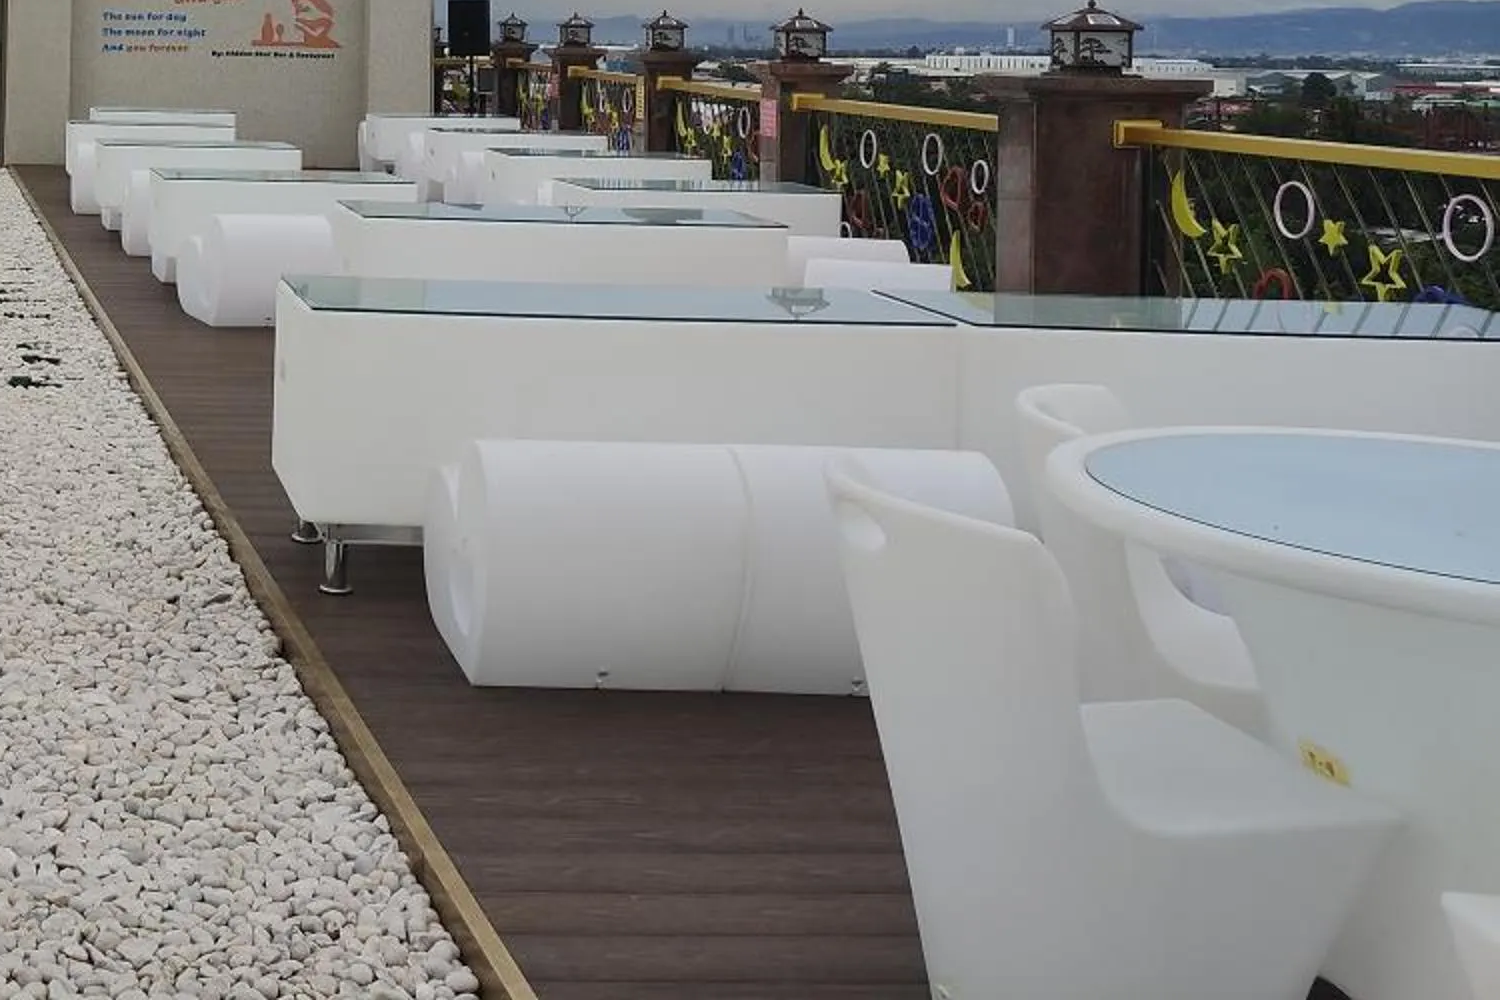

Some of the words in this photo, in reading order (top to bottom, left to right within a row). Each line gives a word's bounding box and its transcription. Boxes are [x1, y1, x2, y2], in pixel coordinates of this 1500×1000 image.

[102, 11, 122, 21] The
[147, 11, 164, 21] for
[166, 12, 187, 23] day
[102, 27, 122, 37] The
[125, 29, 155, 37] moon
[157, 27, 174, 37] for
